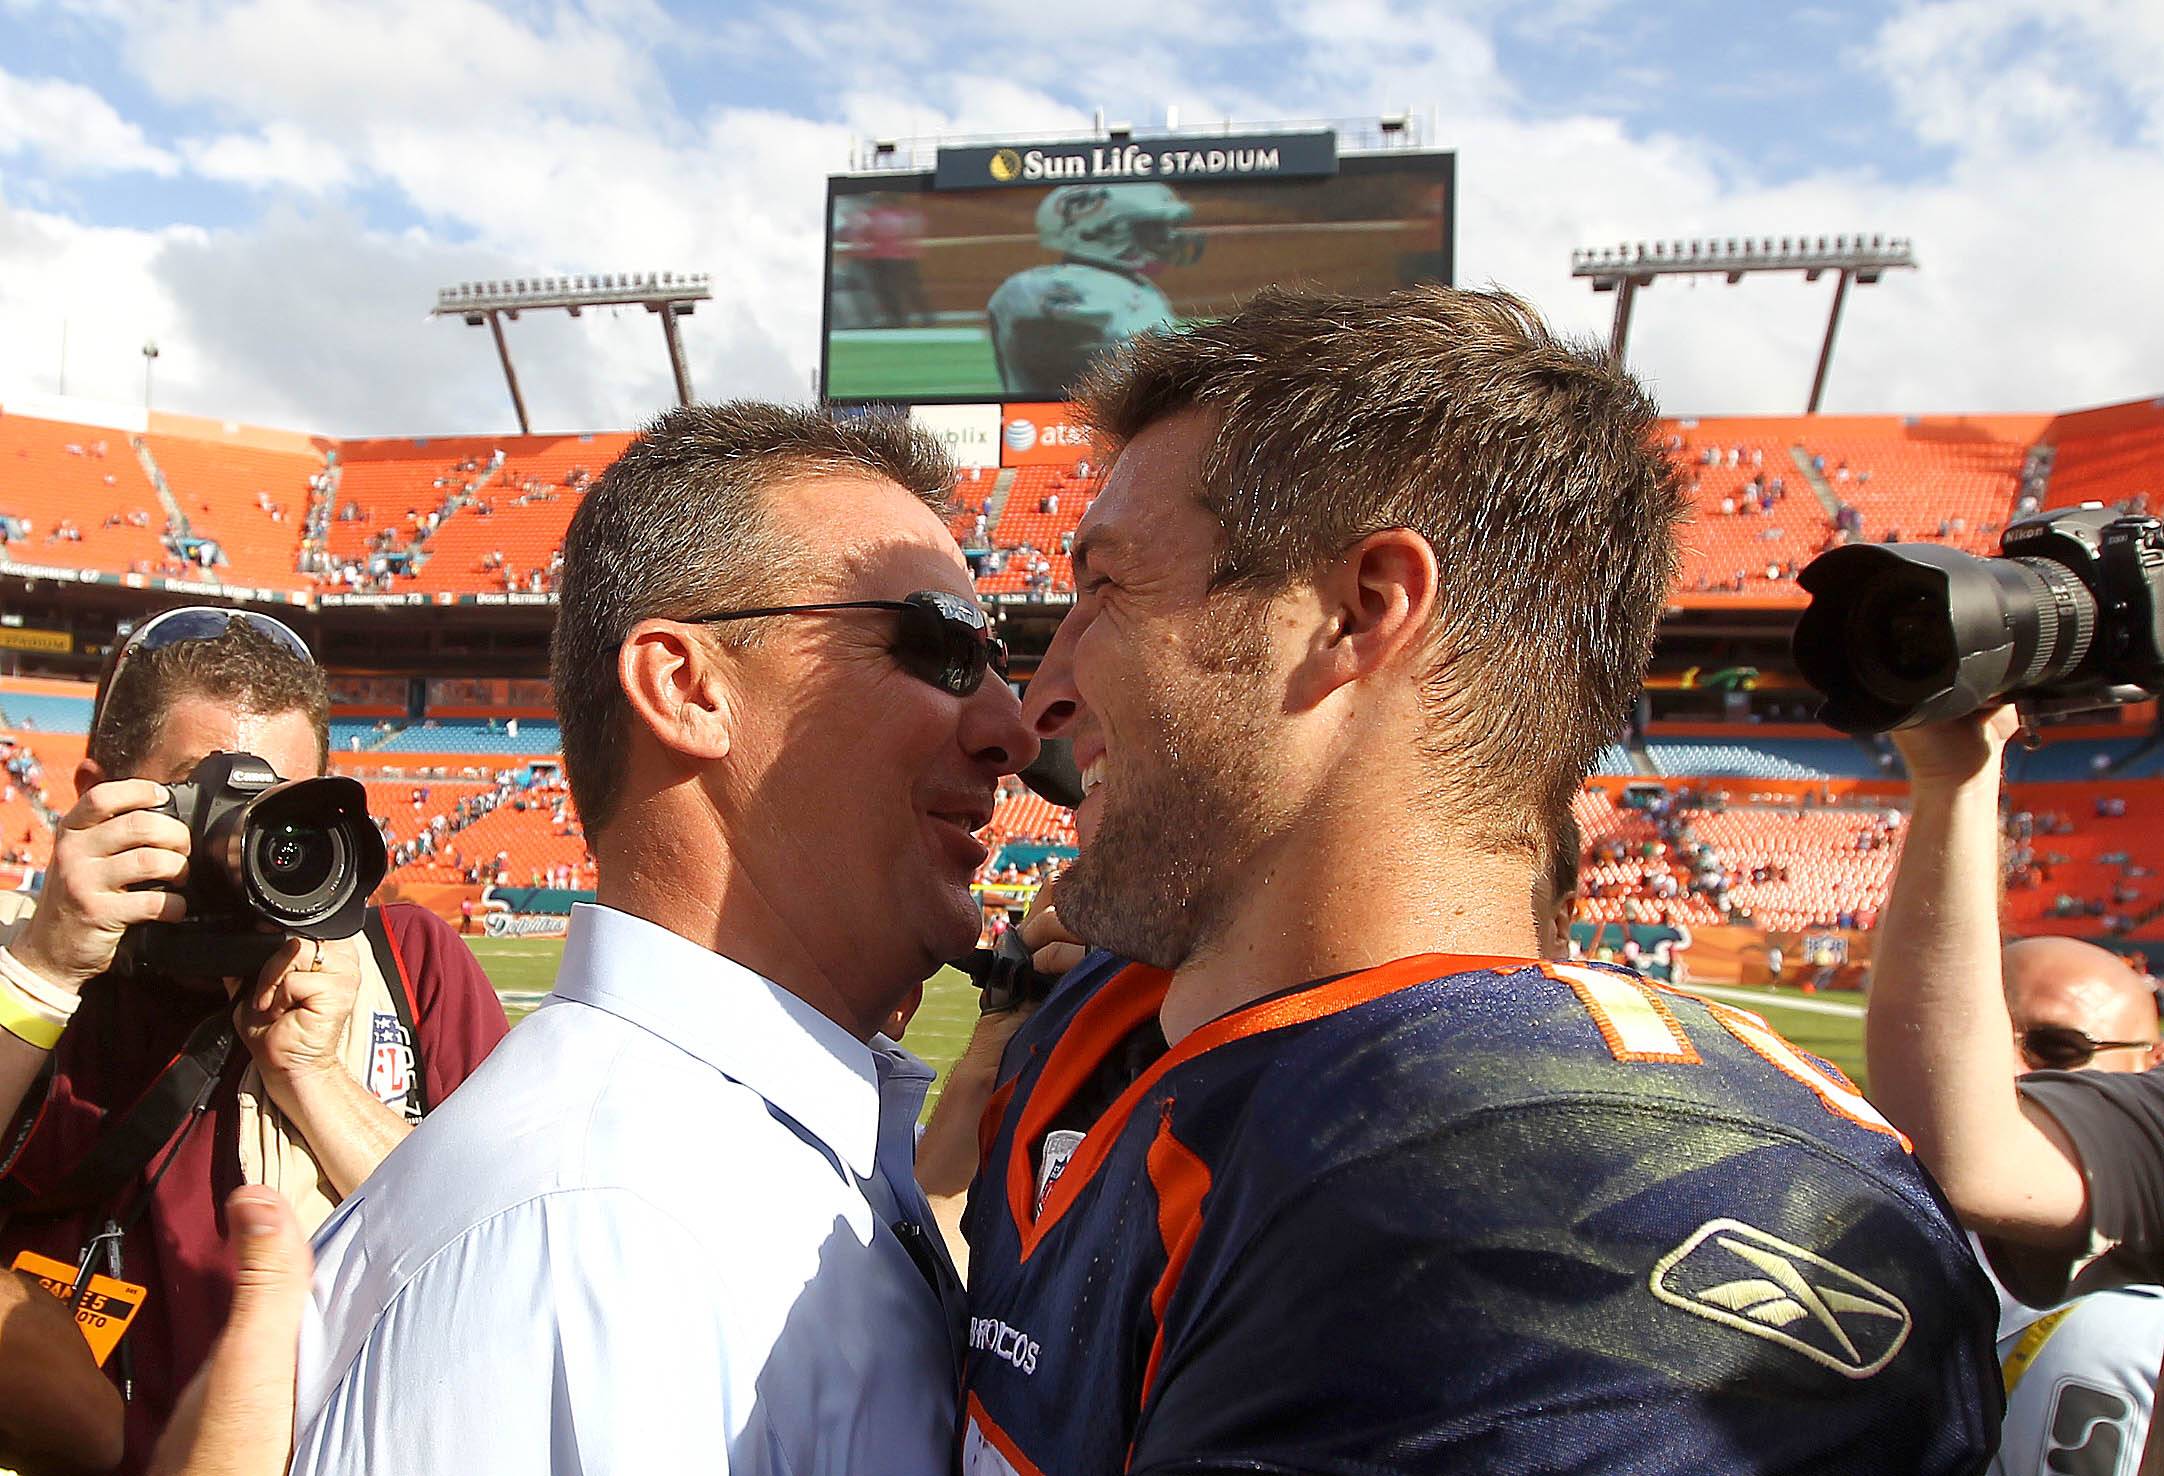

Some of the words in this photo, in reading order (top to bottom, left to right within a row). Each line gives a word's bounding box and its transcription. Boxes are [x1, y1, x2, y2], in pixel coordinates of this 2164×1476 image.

[1023, 150, 1086, 179] Sun
[1092, 145, 1152, 177] Life
[1159, 148, 1280, 176] STADIUM
[939, 426, 988, 443] blix
[2006, 526, 2044, 542] Nikon
[1045, 592, 1071, 605] DAN
[231, 770, 275, 783] Canon
[91, 1296, 108, 1311] 5
[76, 1311, 107, 1328] OTO
